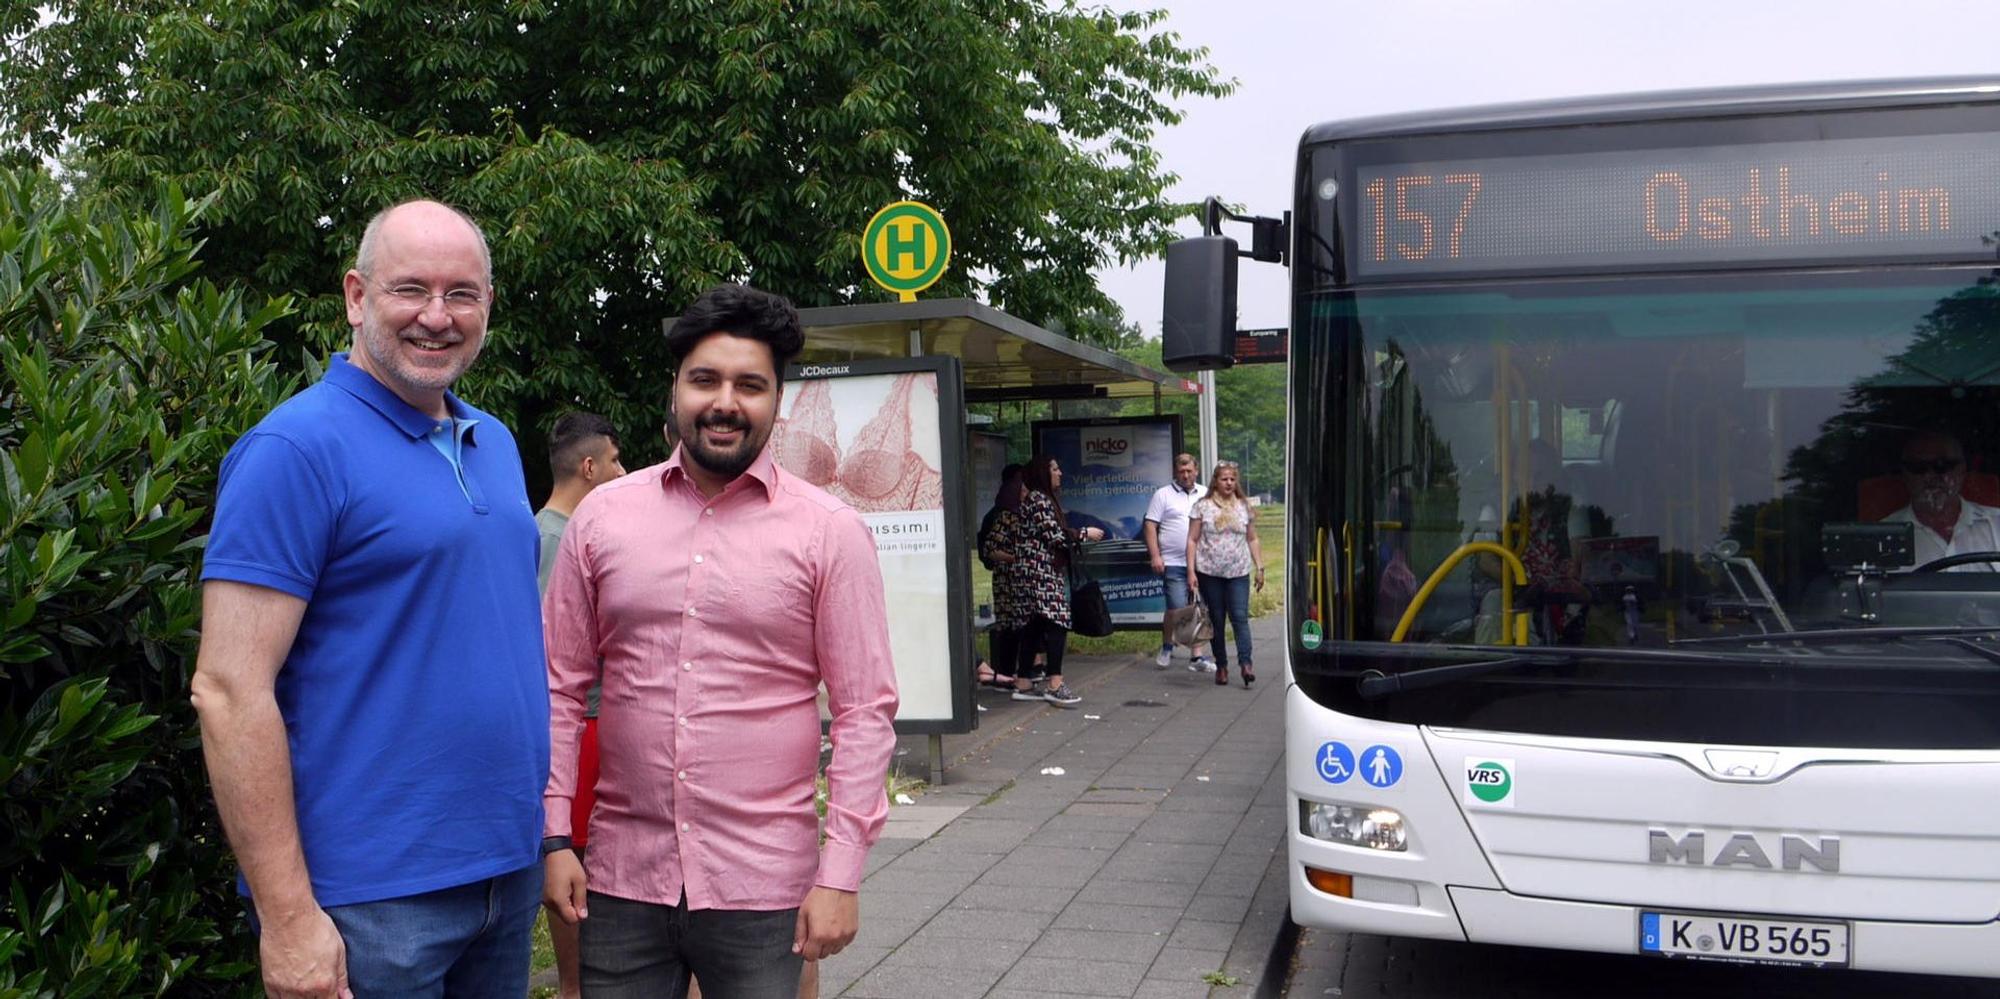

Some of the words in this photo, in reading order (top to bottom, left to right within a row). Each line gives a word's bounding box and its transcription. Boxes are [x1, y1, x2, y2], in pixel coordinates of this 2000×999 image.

[1366, 173, 1481, 261] 157
[1642, 166, 1951, 241] Ostheim
[887, 224, 925, 271] H
[800, 366, 850, 377] JCDecaux
[1086, 437, 1128, 451] nicko
[900, 542, 936, 552] lingerie
[1467, 769, 1500, 783] VRS
[1649, 826, 1840, 873] MAN
[1672, 920, 1692, 949] K
[1718, 923, 1760, 952] VB
[1768, 927, 1831, 957] 565
